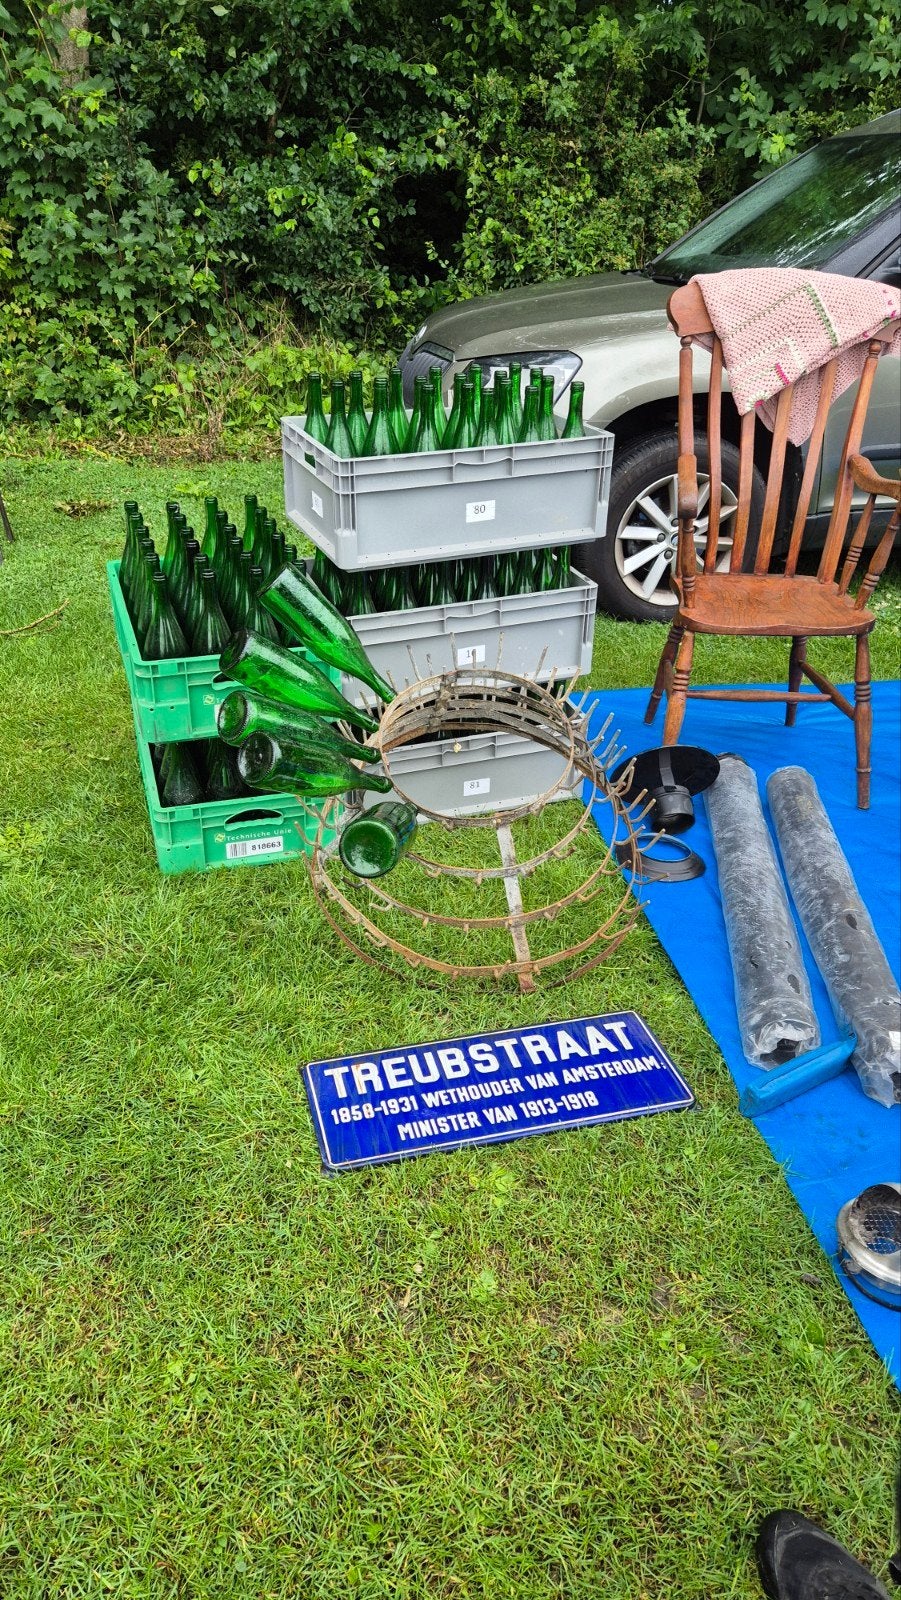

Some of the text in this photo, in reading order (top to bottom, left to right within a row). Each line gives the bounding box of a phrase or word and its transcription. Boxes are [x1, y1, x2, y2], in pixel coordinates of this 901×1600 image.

[473, 504, 486, 515] 80
[469, 781, 480, 789] 81
[227, 828, 292, 841] Technische Unie
[251, 841, 281, 851] 818663
[323, 1021, 634, 1098] TREUBSTRAAT
[331, 1095, 419, 1125] 1858-1931
[421, 1077, 525, 1108] WETHOUDER
[524, 1071, 560, 1090] VAN
[397, 1090, 600, 1141] MINISTER VAN 1913-1918
